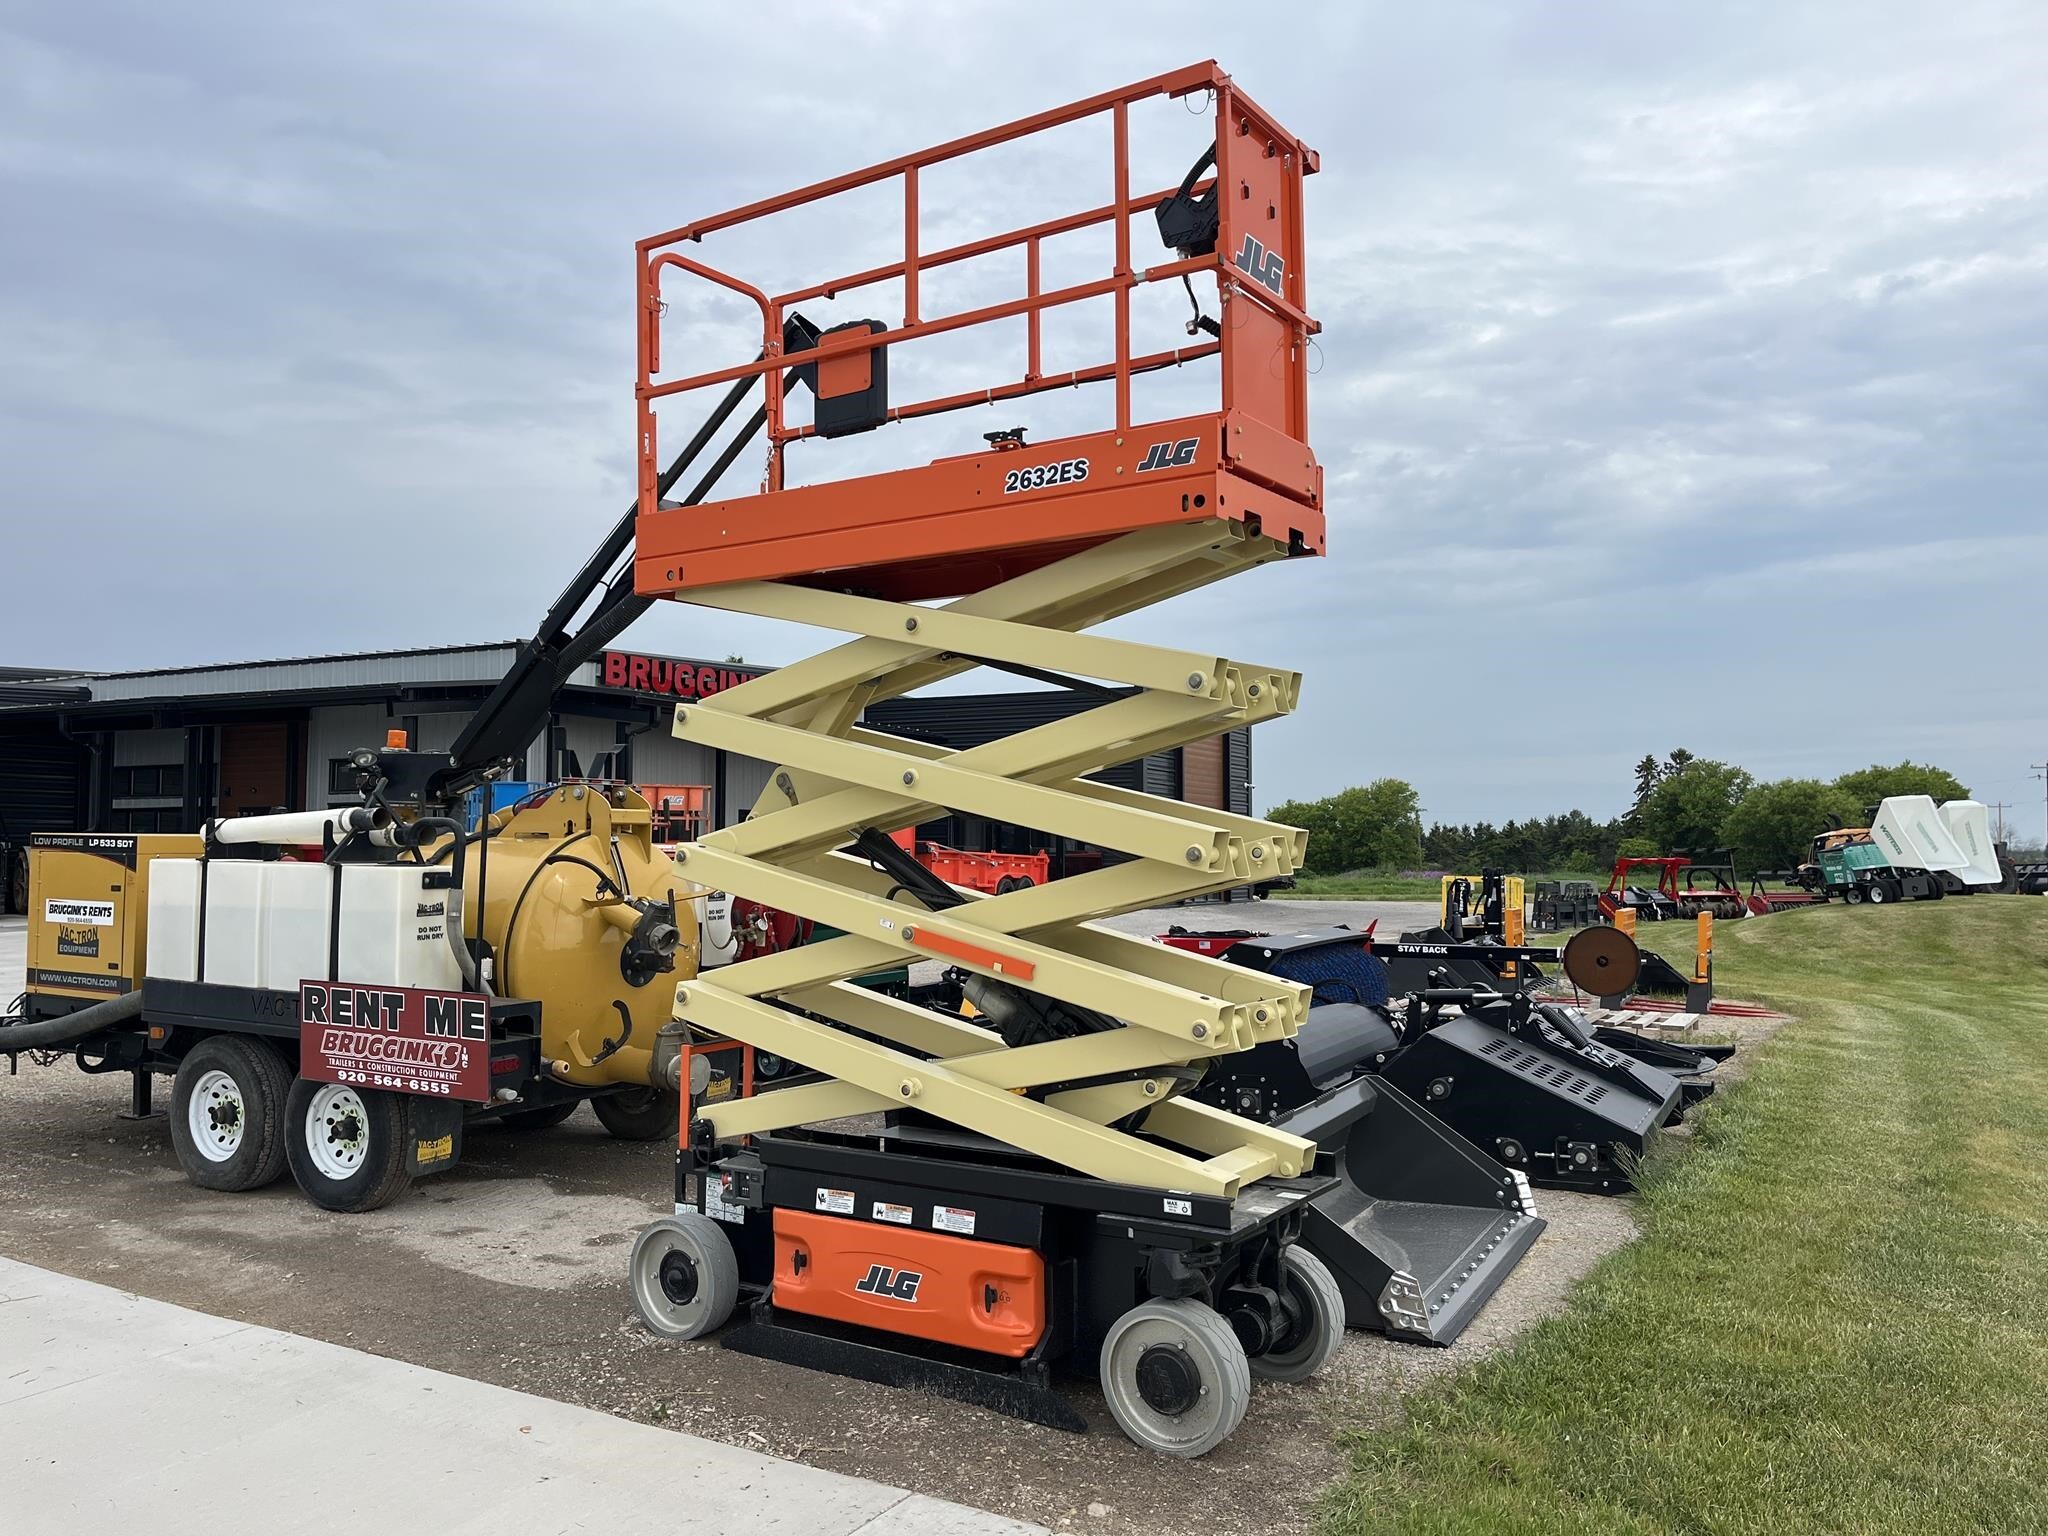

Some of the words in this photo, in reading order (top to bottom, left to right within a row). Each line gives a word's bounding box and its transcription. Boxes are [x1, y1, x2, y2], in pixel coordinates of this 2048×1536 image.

[1234, 232, 1285, 298] JLG
[1136, 437, 1200, 473] JLG
[1004, 457, 1089, 494] 2632ES
[34, 837, 51, 845] LOW
[52, 838, 84, 846] PROFILE
[89, 838, 99, 847] LP
[100, 839, 116, 847] 533
[117, 839, 134, 848] SDT
[88, 906, 112, 917] RENTS
[59, 944, 97, 955] EQUIPMENT
[1398, 945, 1421, 953] STAY
[1422, 946, 1448, 954] BACK
[40, 973, 118, 988] WWW.VACTRON.COM
[302, 985, 405, 1032] RENT
[424, 995, 486, 1042] ME
[320, 1029, 462, 1069] BRUGGINK'S
[461, 1046, 469, 1069] INC
[328, 1057, 356, 1069] TRAILERS
[358, 1061, 364, 1070] &
[366, 1062, 416, 1076] CONSTRUCTION
[419, 1069, 458, 1081] EQUIPMENT
[337, 1070, 450, 1095] 920-564-6555
[855, 1264, 922, 1302] JLG
